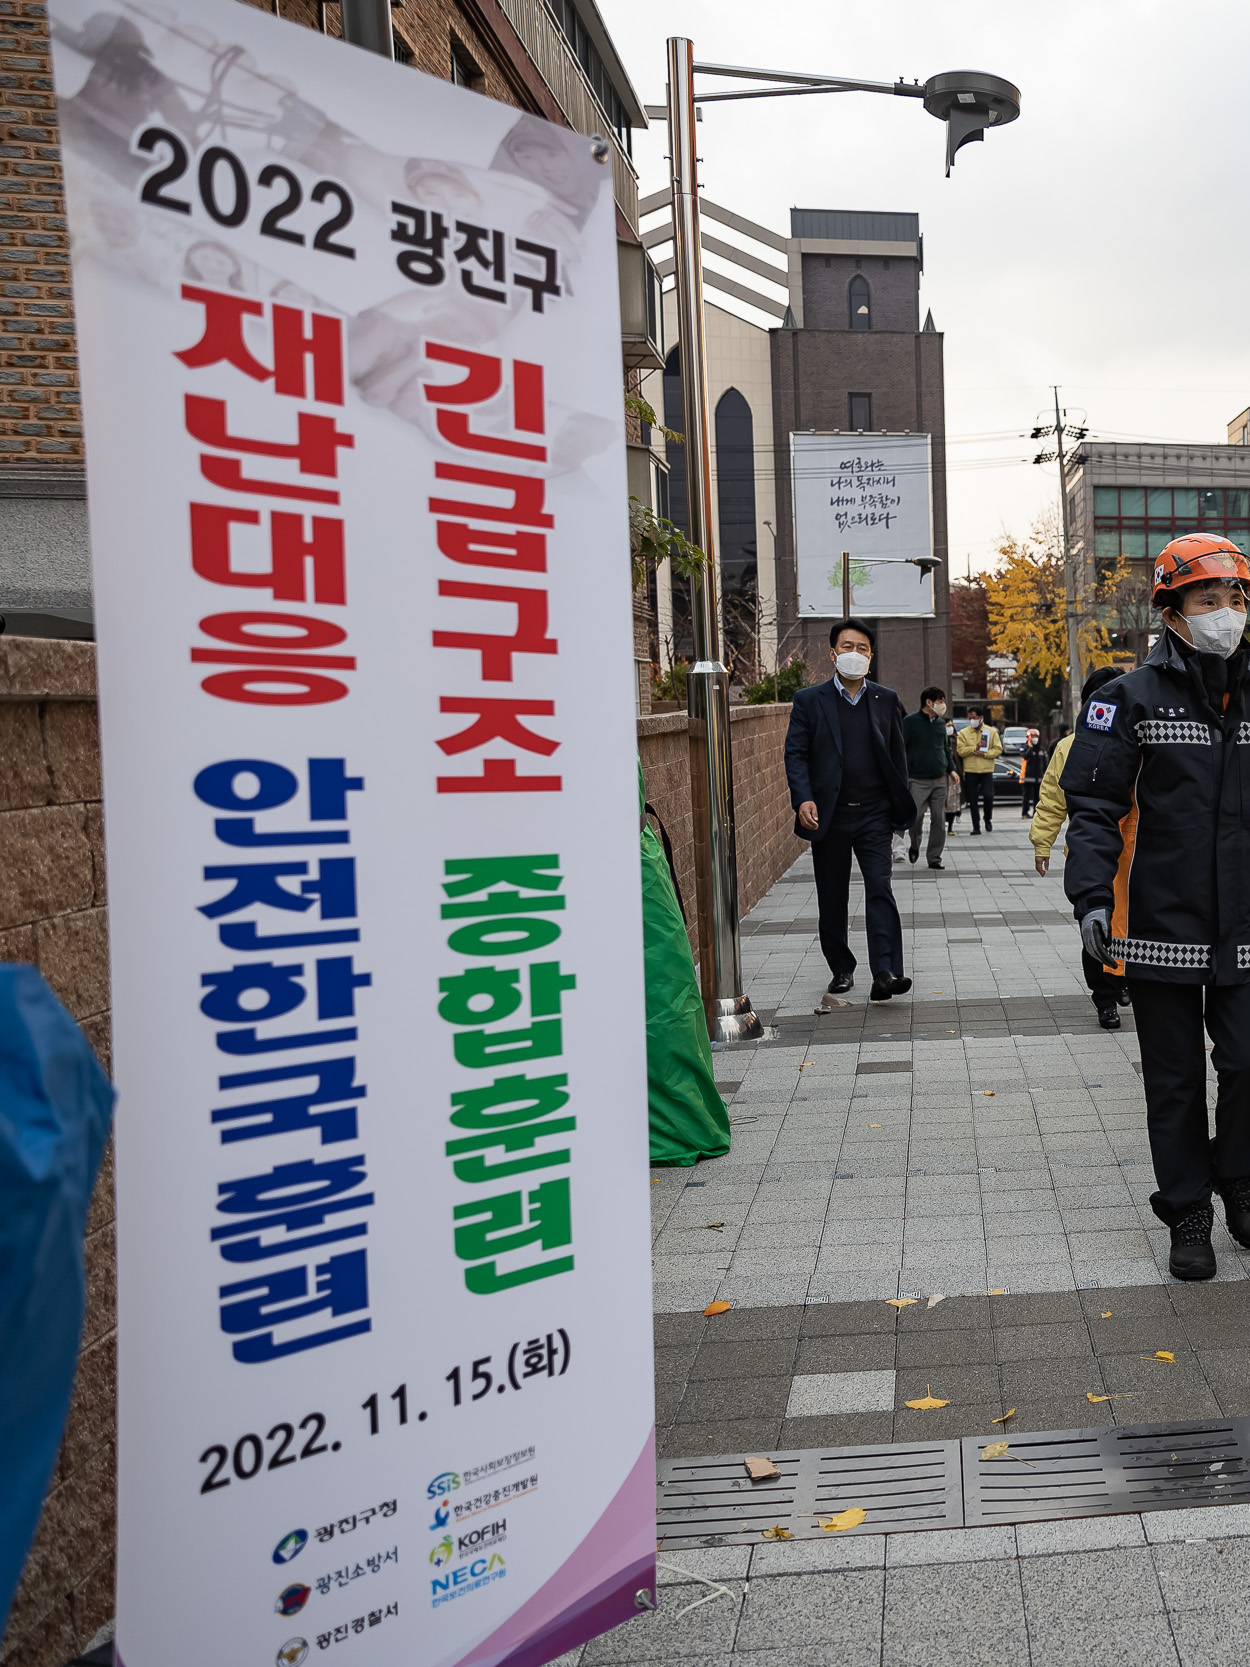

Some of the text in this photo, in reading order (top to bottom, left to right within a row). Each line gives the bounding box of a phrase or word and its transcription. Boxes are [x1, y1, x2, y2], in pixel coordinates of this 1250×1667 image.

[138, 127, 561, 314] 2022 광진구
[830, 475, 896, 492] 나의 목자시니
[840, 457, 887, 474] 여호와는
[830, 493, 901, 510] 내게 부족함이
[835, 511, 898, 533] 없으리로다
[423, 341, 563, 794] 긴급구조
[1088, 723, 1110, 732] KOREA
[173, 284, 375, 1364] 재난대응 안전한국훈련
[438, 854, 577, 1295] 종합훈련
[198, 1328, 572, 1496] 2022. 11. 15.(화)
[463, 1445, 536, 1482] 한국사회보장정보원
[453, 1473, 538, 1517] 한국건강증진개발원
[314, 1498, 399, 1543] 광진구청
[458, 1518, 507, 1551] KOFIH
[315, 1545, 399, 1595] 광진소방서
[431, 1553, 506, 1596] NECA
[431, 1568, 507, 1608] 한국보건의료연구원
[316, 1601, 399, 1651] 광진경찰서
